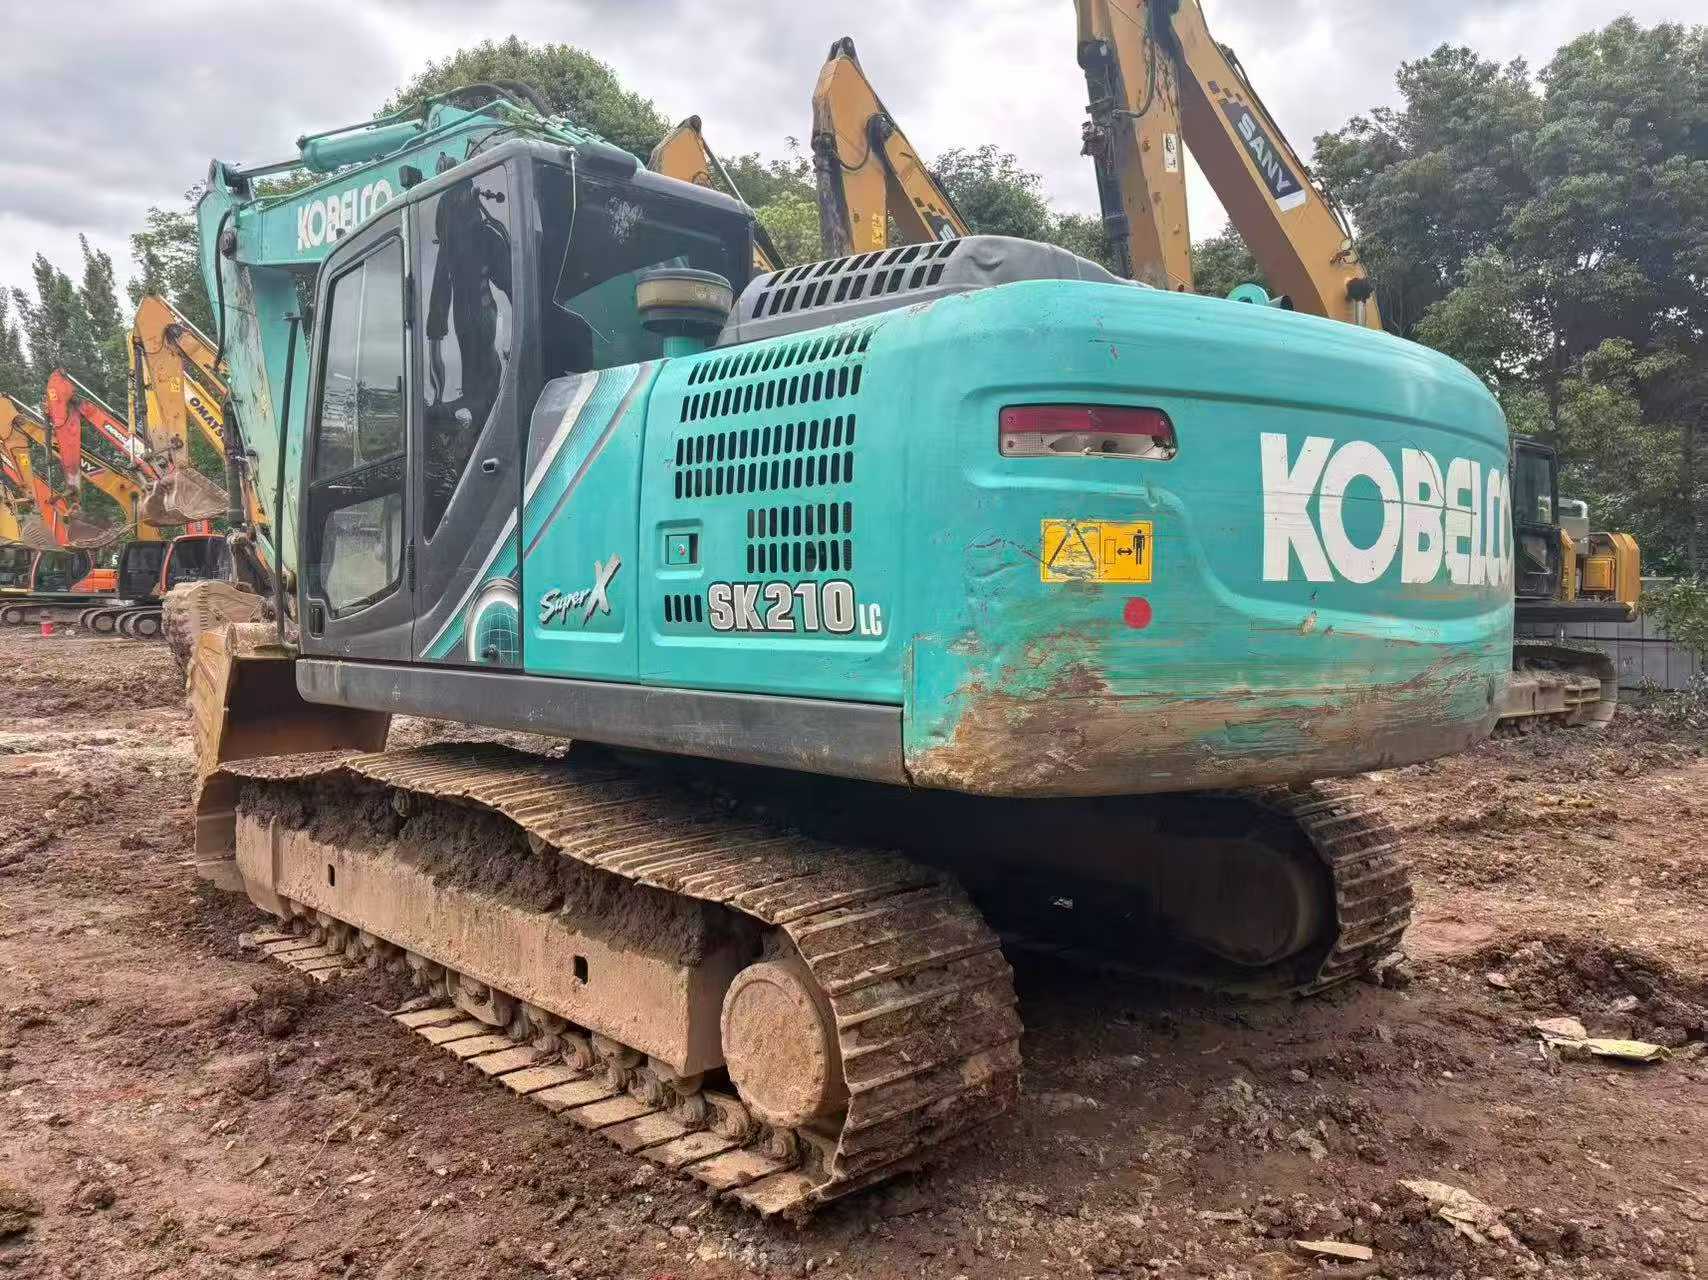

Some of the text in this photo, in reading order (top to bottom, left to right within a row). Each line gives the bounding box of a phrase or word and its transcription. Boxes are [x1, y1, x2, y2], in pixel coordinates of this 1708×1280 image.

[1237, 112, 1292, 193] SANY
[190, 397, 225, 438] OMATS
[707, 578, 883, 636] SK210 LC
